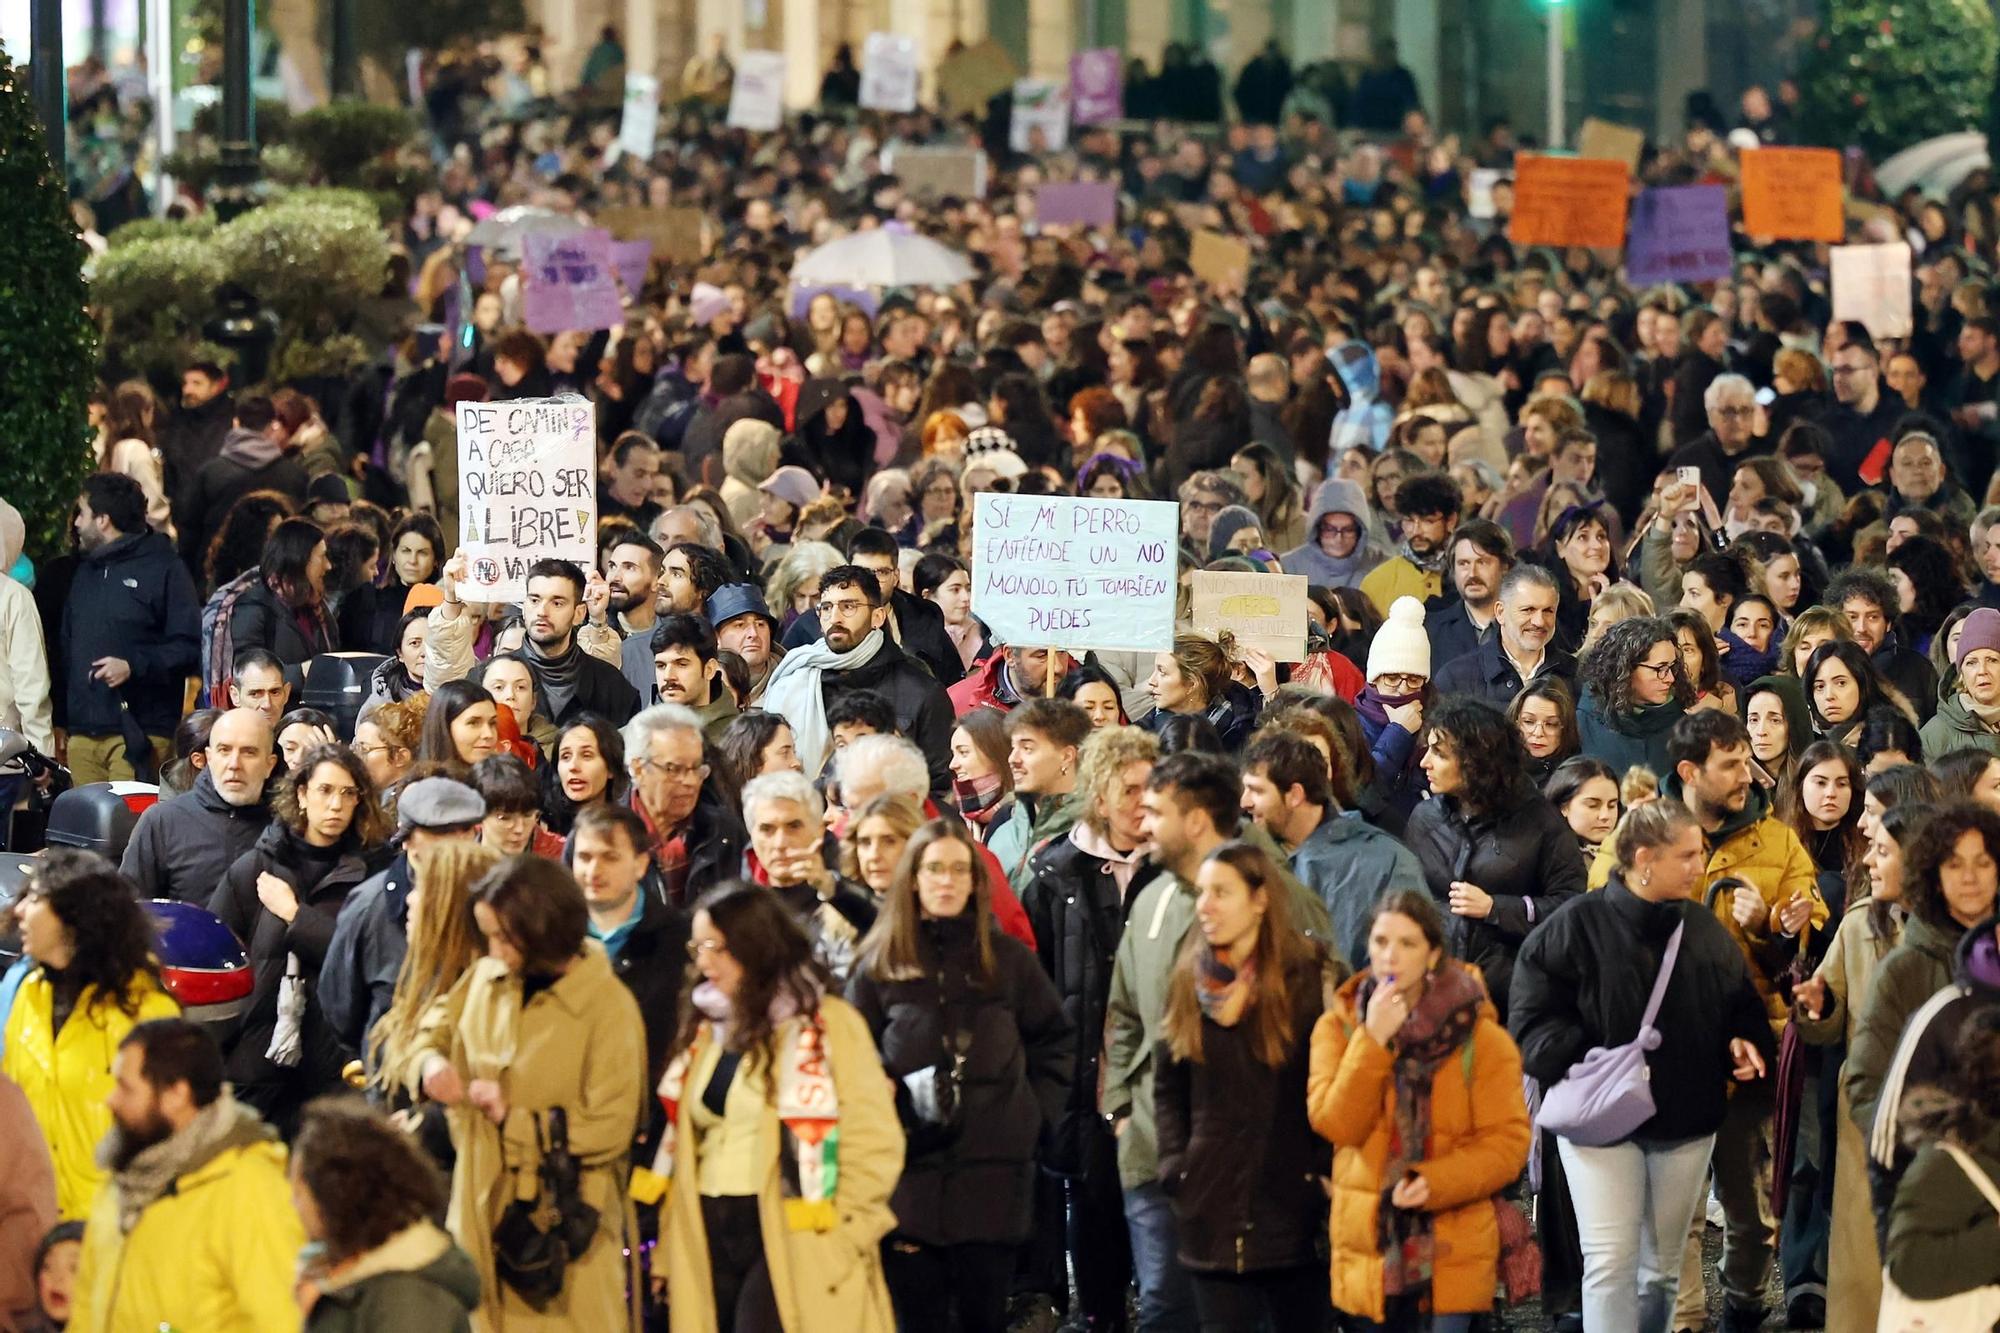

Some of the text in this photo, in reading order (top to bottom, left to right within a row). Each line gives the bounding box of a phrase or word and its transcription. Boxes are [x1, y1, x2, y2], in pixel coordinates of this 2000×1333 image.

[464, 408, 497, 433] DE
[468, 439, 483, 461] A
[552, 468, 592, 498] SER
[1073, 505, 1141, 535] PERRO
[986, 535, 1074, 564] ENTIENDE
[1089, 545, 1118, 564] UN
[1028, 607, 1093, 632] PUEDES
